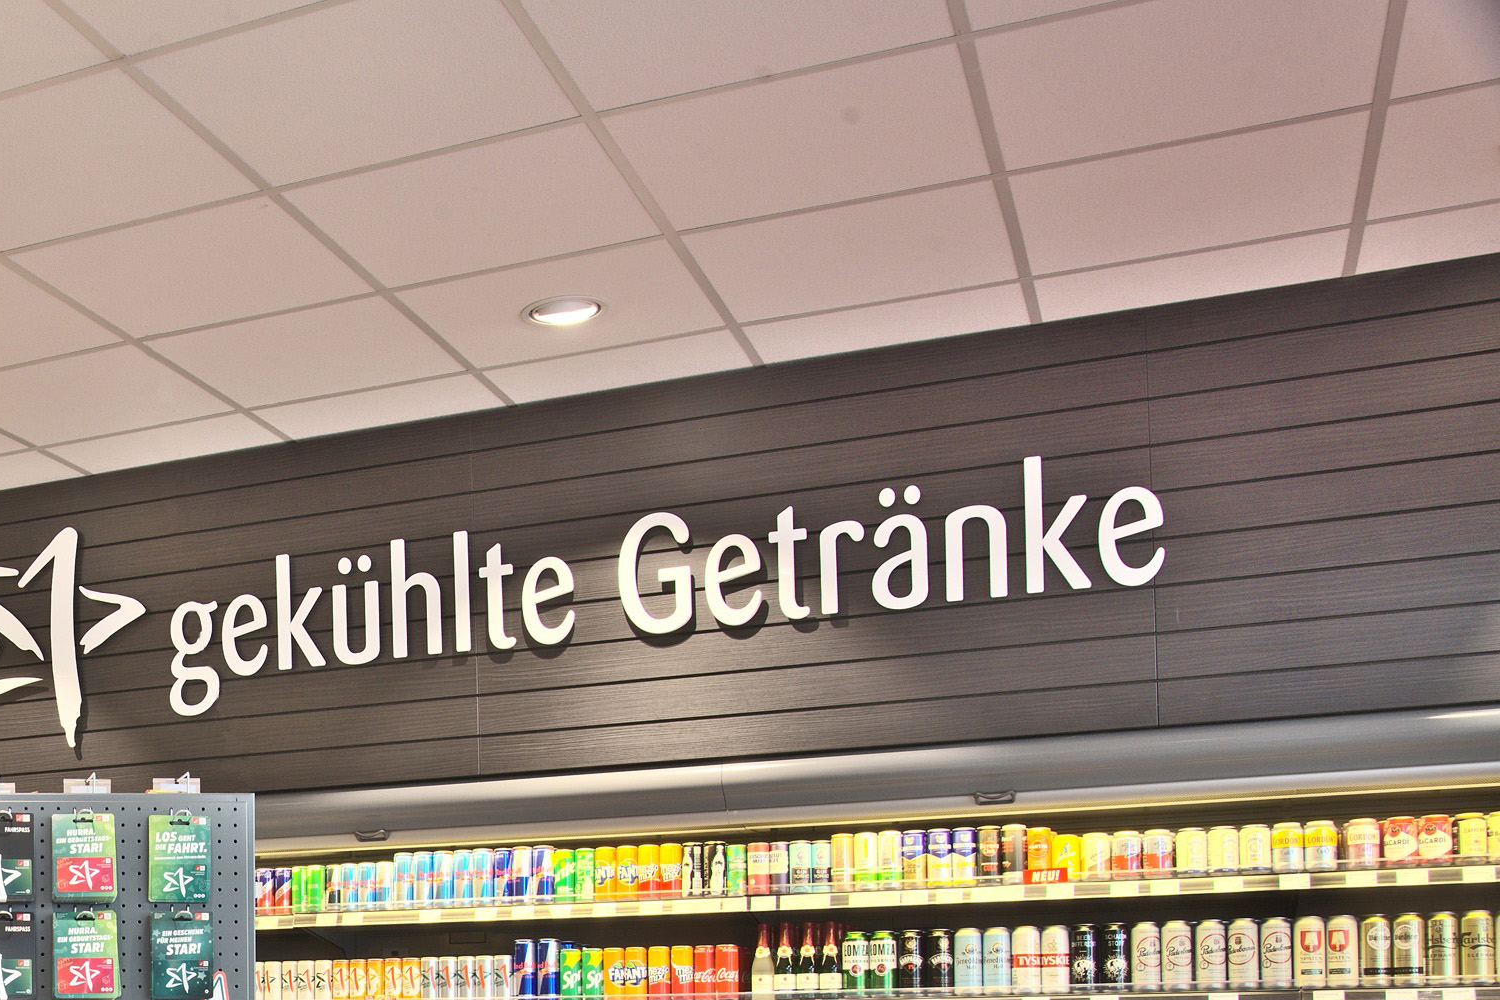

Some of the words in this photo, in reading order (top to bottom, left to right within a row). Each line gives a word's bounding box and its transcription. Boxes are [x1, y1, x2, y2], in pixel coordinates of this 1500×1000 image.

[170, 530, 577, 717] gekühlte
[618, 455, 1167, 635] Getränke
[155, 831, 178, 843] LOS
[178, 834, 196, 842] GEHT
[167, 841, 208, 854] FAHRT.
[4, 925, 31, 933] FAHRSPASS
[173, 929, 205, 937] GESCHENK
[68, 934, 114, 942] GEBURTSTAGS-
[156, 936, 168, 944] FÜR
[1461, 931, 1496, 950] Carlsbe
[70, 942, 105, 954] STAR!
[166, 942, 202, 955] STAR!
[1017, 955, 1041, 966] TYSK
[624, 967, 647, 982] FANT
